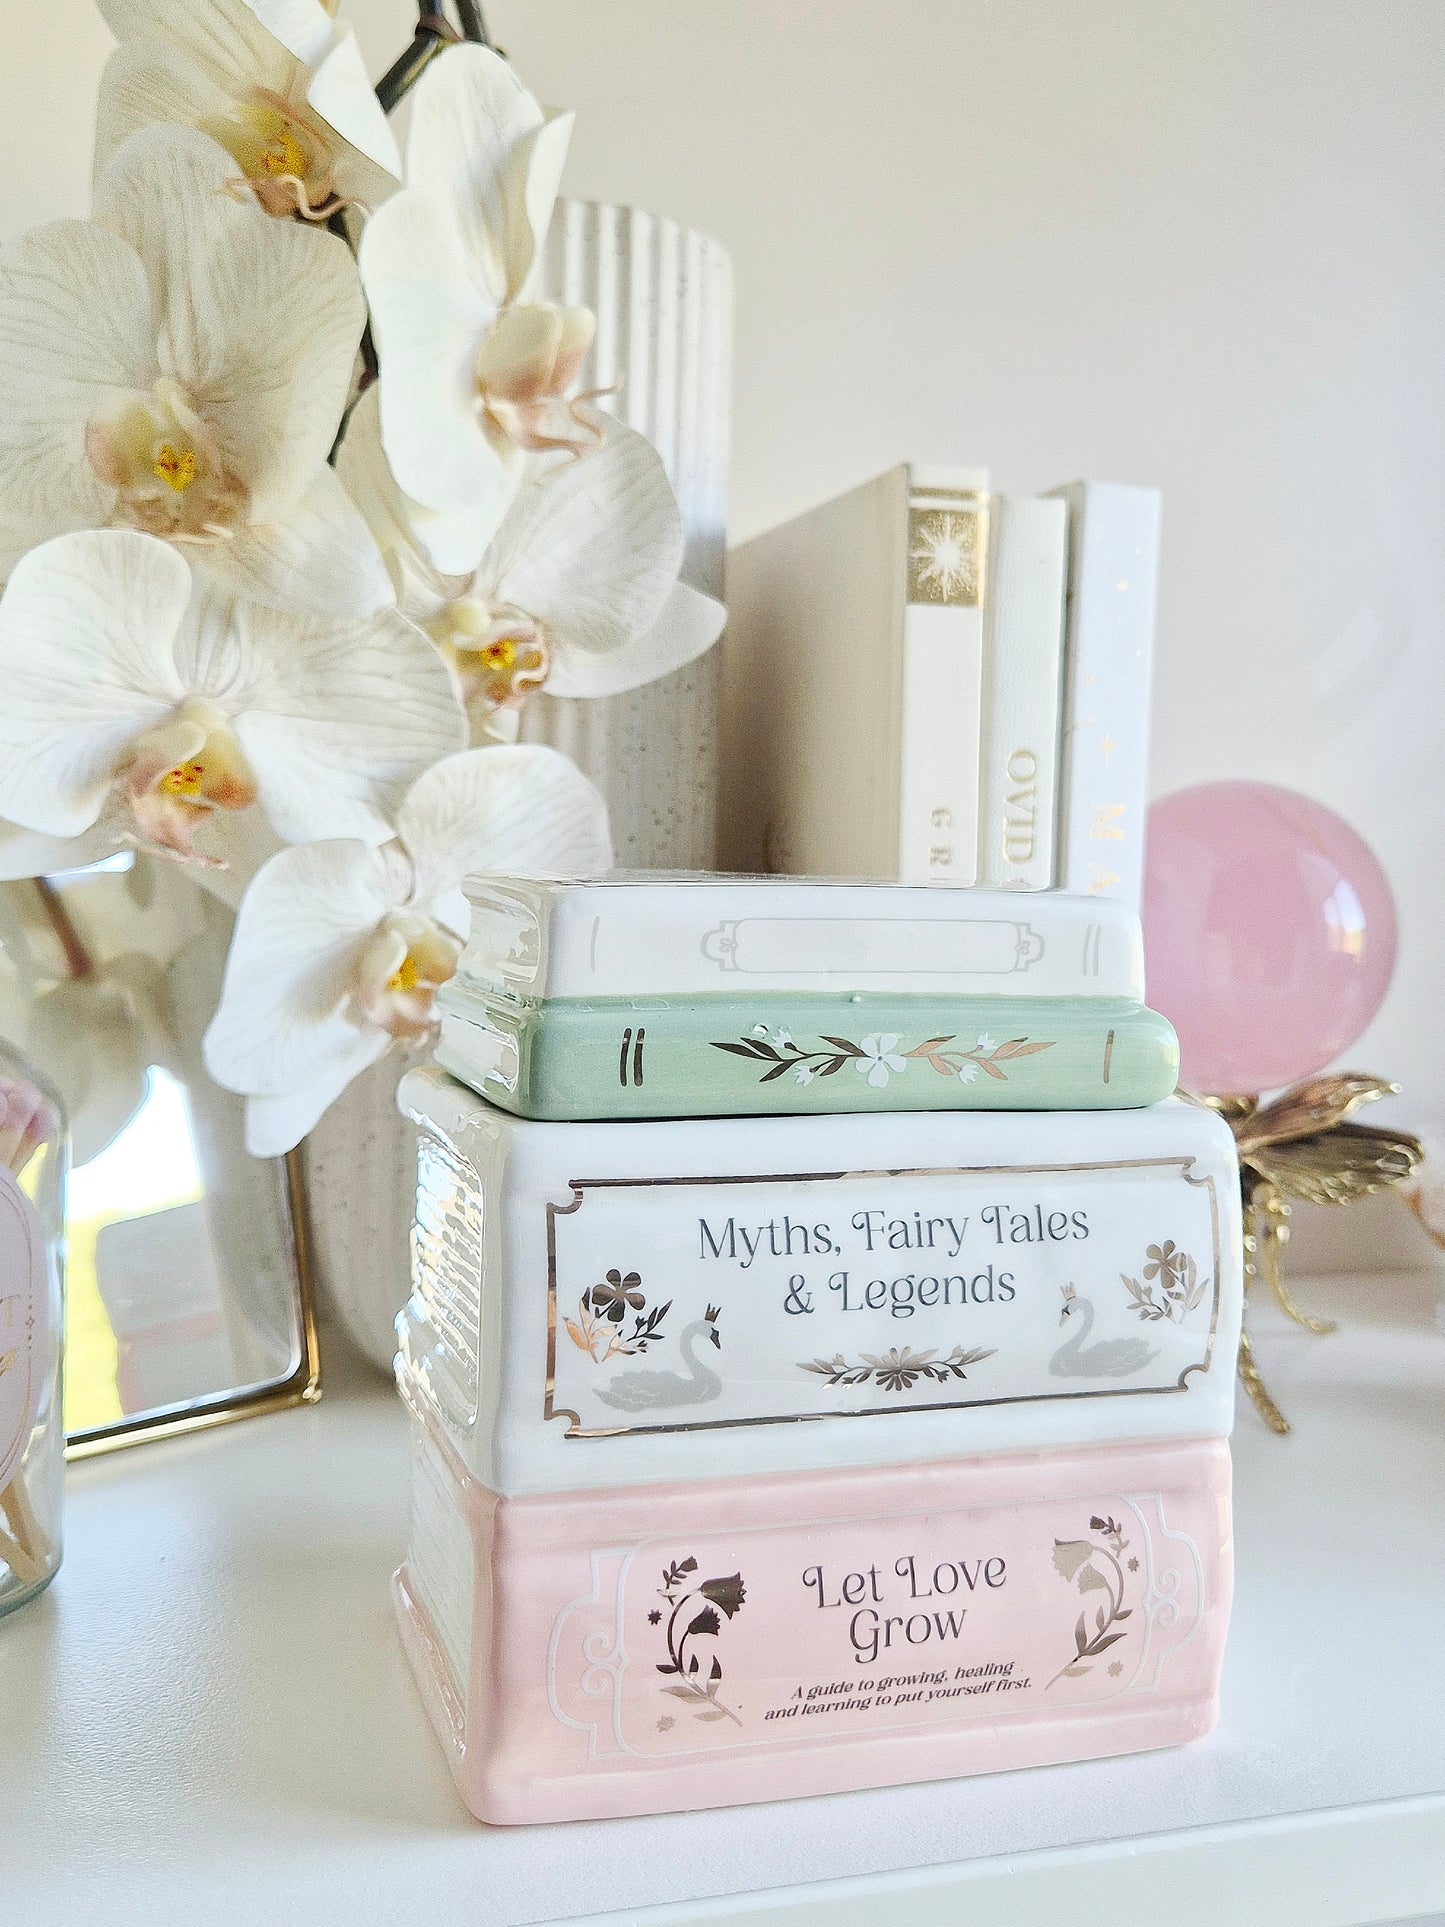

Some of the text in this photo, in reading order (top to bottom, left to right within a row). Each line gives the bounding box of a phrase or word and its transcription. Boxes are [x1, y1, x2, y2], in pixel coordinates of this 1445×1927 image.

[1003, 748, 1035, 864] OVID
[698, 1203, 1090, 1268] Myths, Fairy Tales
[783, 1265, 1016, 1318] & Legends
[802, 1556, 1007, 1608] Let Love
[850, 1608, 967, 1663] Grow
[764, 1674, 1032, 1720] and learning to put yourself first.
[791, 1661, 1015, 1701] A guide to growing, healing
